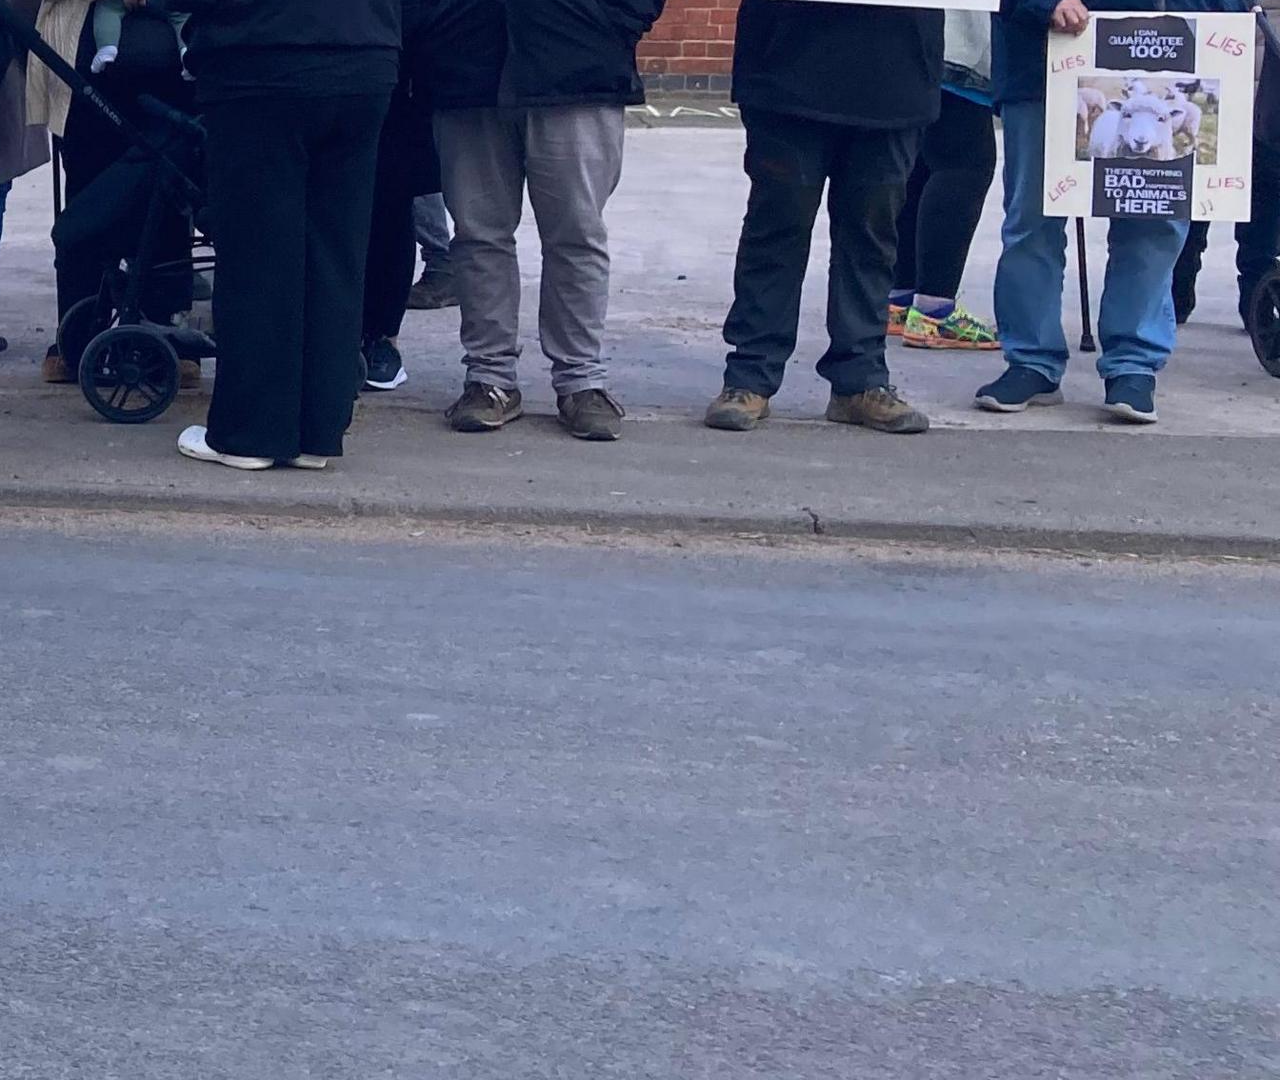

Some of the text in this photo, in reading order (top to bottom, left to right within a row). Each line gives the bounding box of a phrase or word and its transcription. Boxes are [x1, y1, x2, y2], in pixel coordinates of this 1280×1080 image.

[1108, 35, 1184, 46] GUARANTEE
[1206, 31, 1247, 57] LIES
[1128, 45, 1177, 58] 100%
[1051, 54, 1086, 73] LIES
[1104, 174, 1146, 188] BAD
[1207, 176, 1245, 190] LIES
[1047, 175, 1078, 202] LIES
[1104, 188, 1187, 201] TO ANIMALS
[1115, 199, 1174, 215] HERE.
